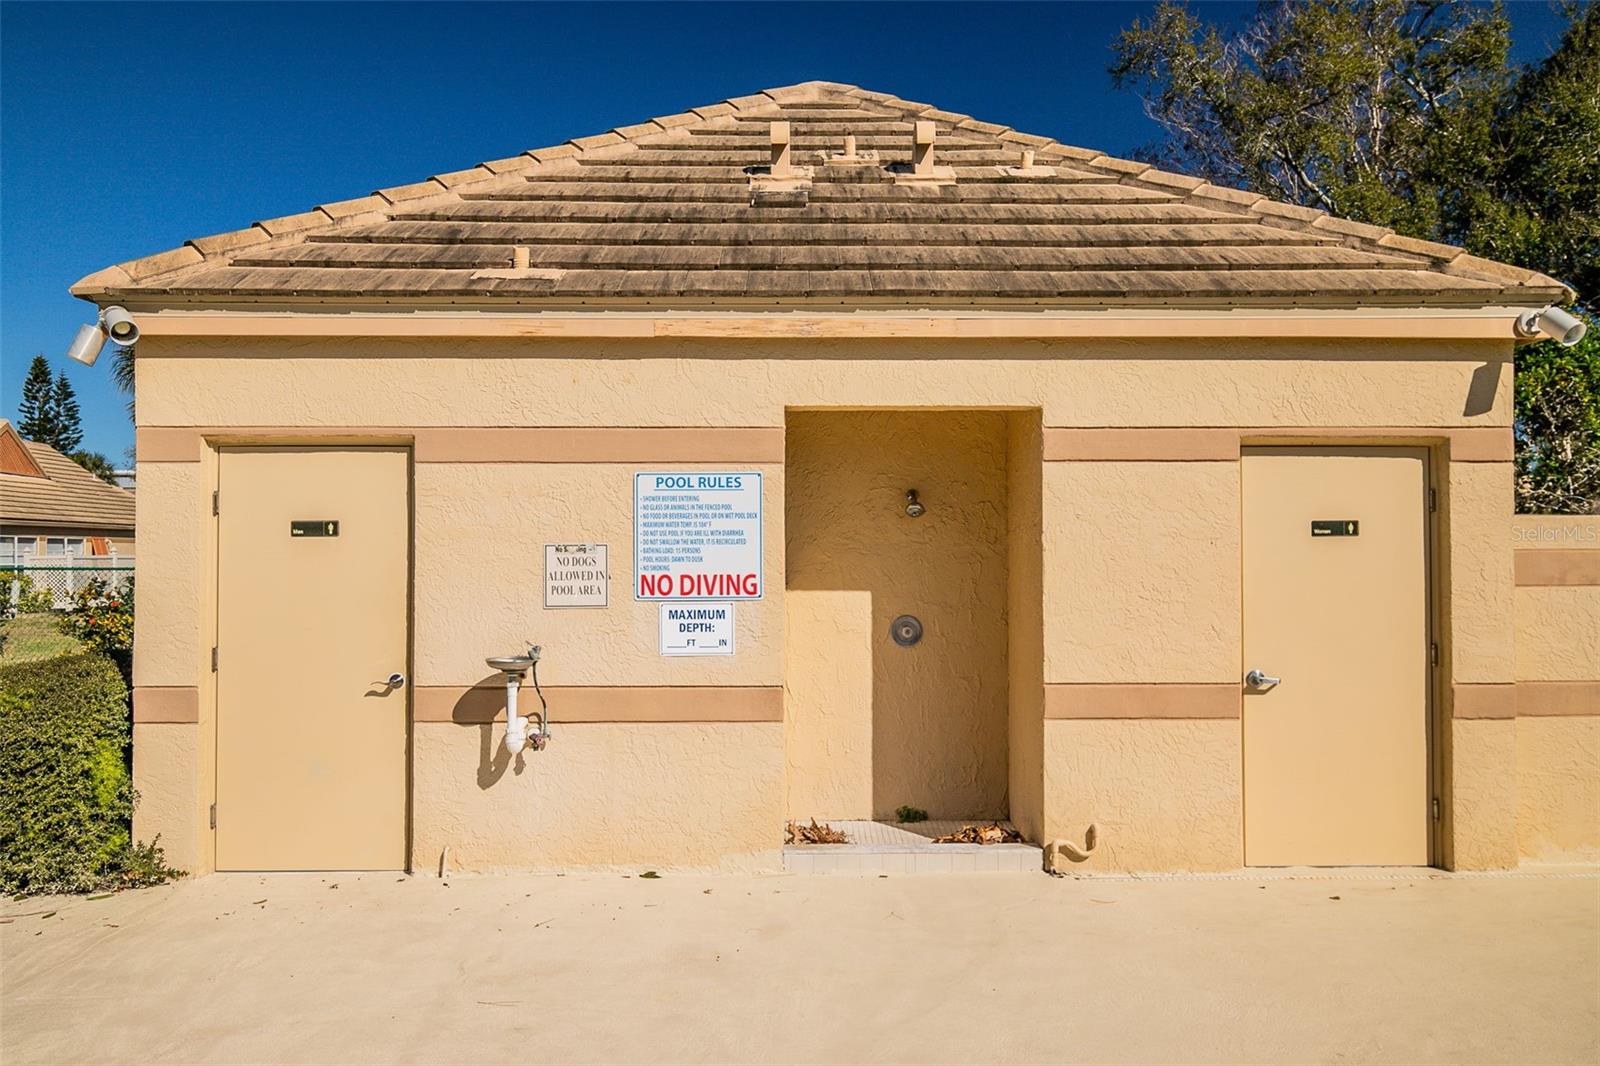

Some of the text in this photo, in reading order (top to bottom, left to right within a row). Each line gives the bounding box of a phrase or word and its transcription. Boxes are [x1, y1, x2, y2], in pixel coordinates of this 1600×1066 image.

[656, 477, 742, 488] POOL RULES
[557, 557, 596, 566] NO DOGS
[550, 571, 605, 580] ALLOWED IN
[552, 585, 601, 595] POOL AREA
[641, 574, 758, 596] NO DIVING
[668, 610, 726, 620] MAXIMUM
[680, 623, 715, 632] DEPTH:
